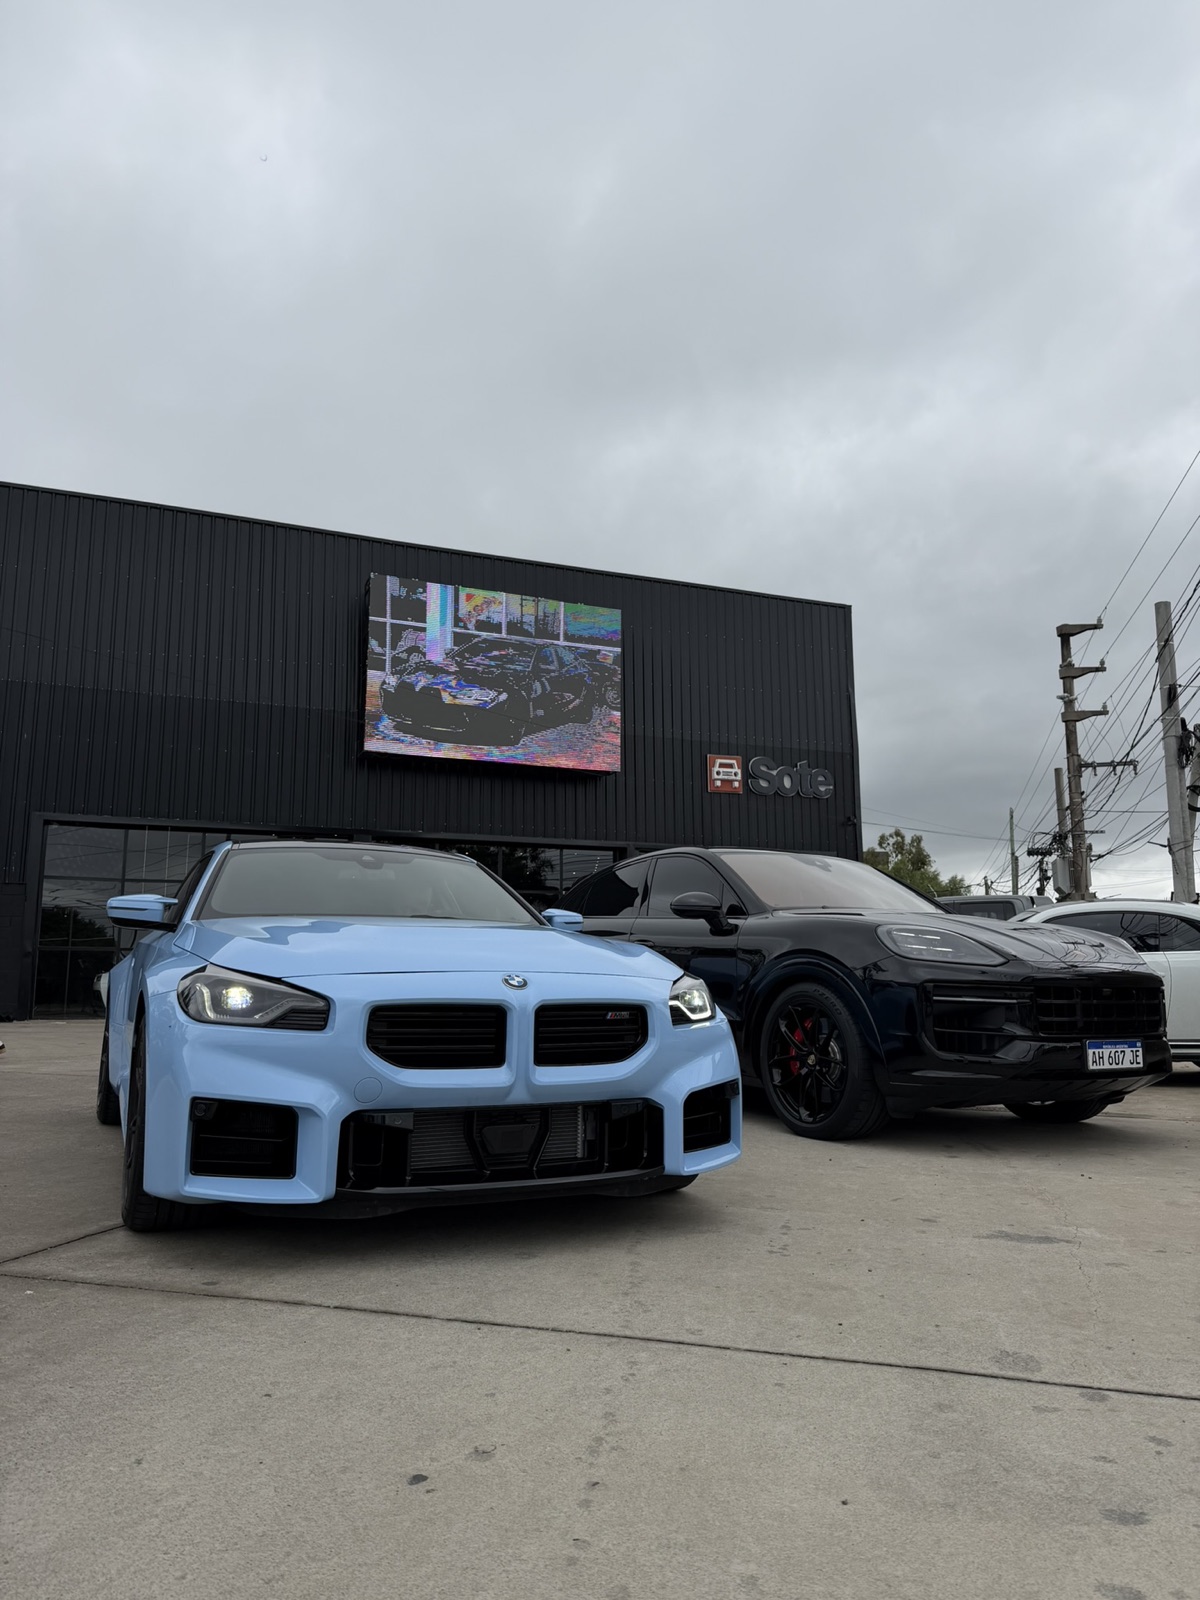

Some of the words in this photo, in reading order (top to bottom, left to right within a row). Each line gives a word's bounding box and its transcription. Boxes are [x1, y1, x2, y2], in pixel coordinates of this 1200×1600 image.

[749, 756, 834, 799] Sote
[1092, 1051, 1105, 1066] AH
[1108, 1050, 1126, 1066] 607
[1129, 1050, 1141, 1065] JE
